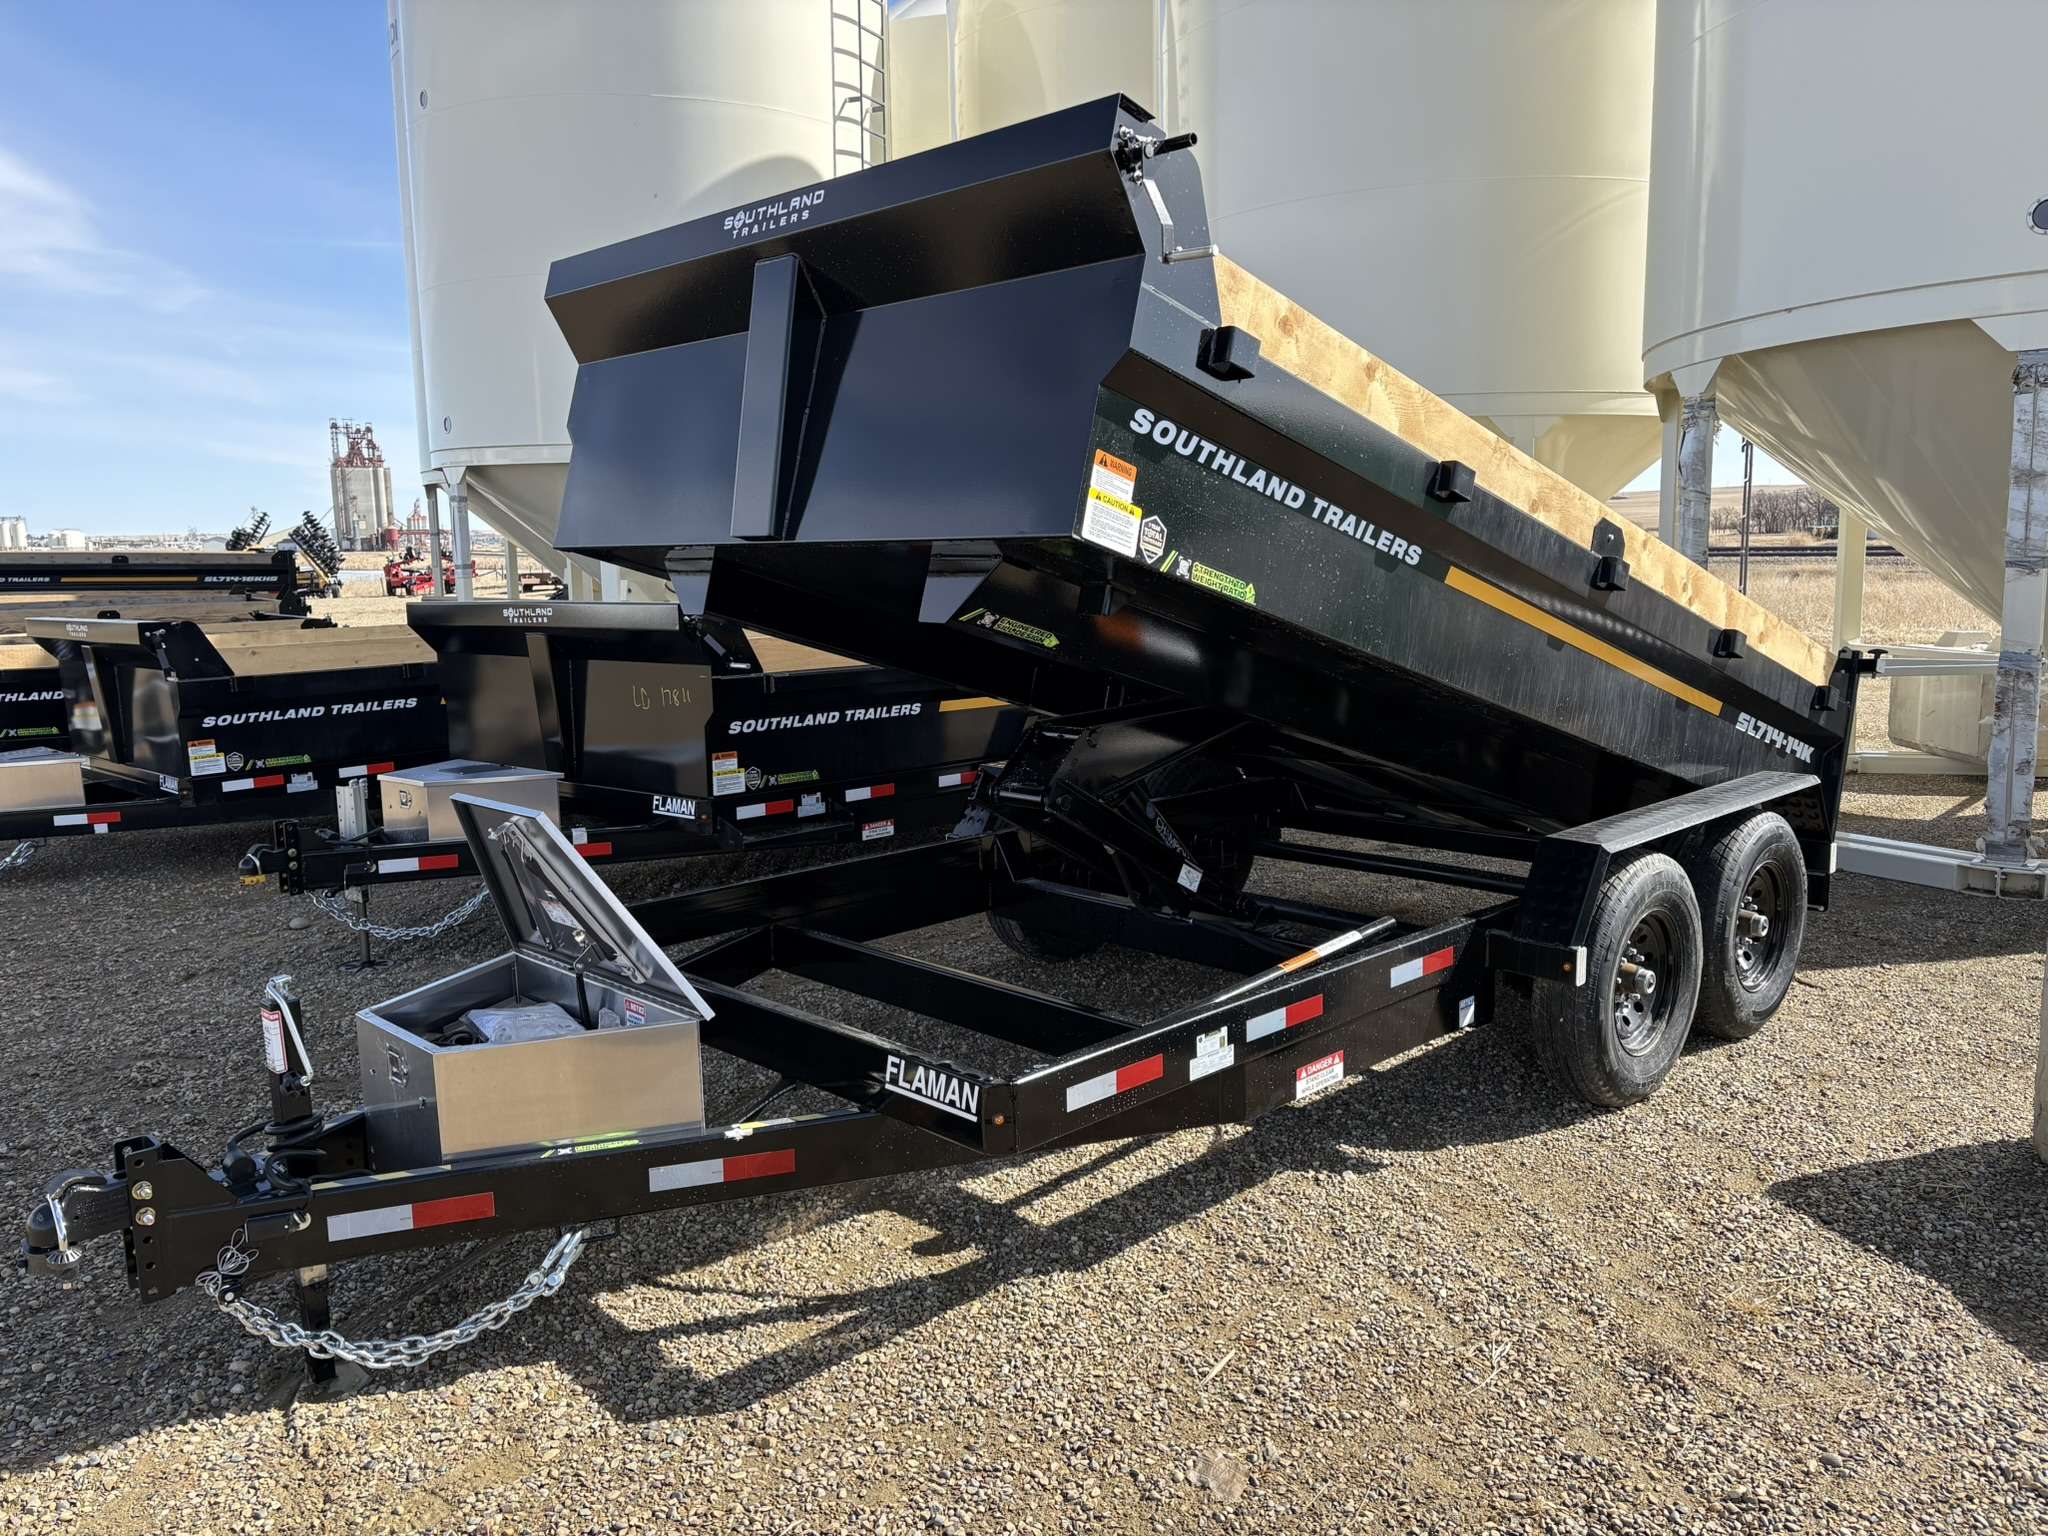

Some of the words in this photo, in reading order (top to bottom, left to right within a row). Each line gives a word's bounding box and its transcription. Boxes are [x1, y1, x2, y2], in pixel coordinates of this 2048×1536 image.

[723, 189, 825, 231] SOUTHLAND
[732, 209, 810, 239] TRAILERS
[1129, 408, 1305, 510] SOUTHLAND
[1312, 497, 1422, 566] TRAILERS
[1102, 495, 1129, 512] CAUTION
[1193, 563, 1235, 587] STRENGTH
[1193, 573, 1222, 591] WEIGHT
[502, 607, 553, 618] SOUTHLAND
[202, 706, 325, 728] SOUTHLAND
[331, 698, 418, 715] TRAILERS
[728, 711, 839, 734] SOUTHLAND
[845, 703, 921, 721] TRAILERS
[1735, 711, 1815, 764] SL714-14K
[653, 796, 696, 815] FLAMAN
[1307, 1057, 1334, 1075] DANGER
[885, 1055, 979, 1114] FLAMAN
